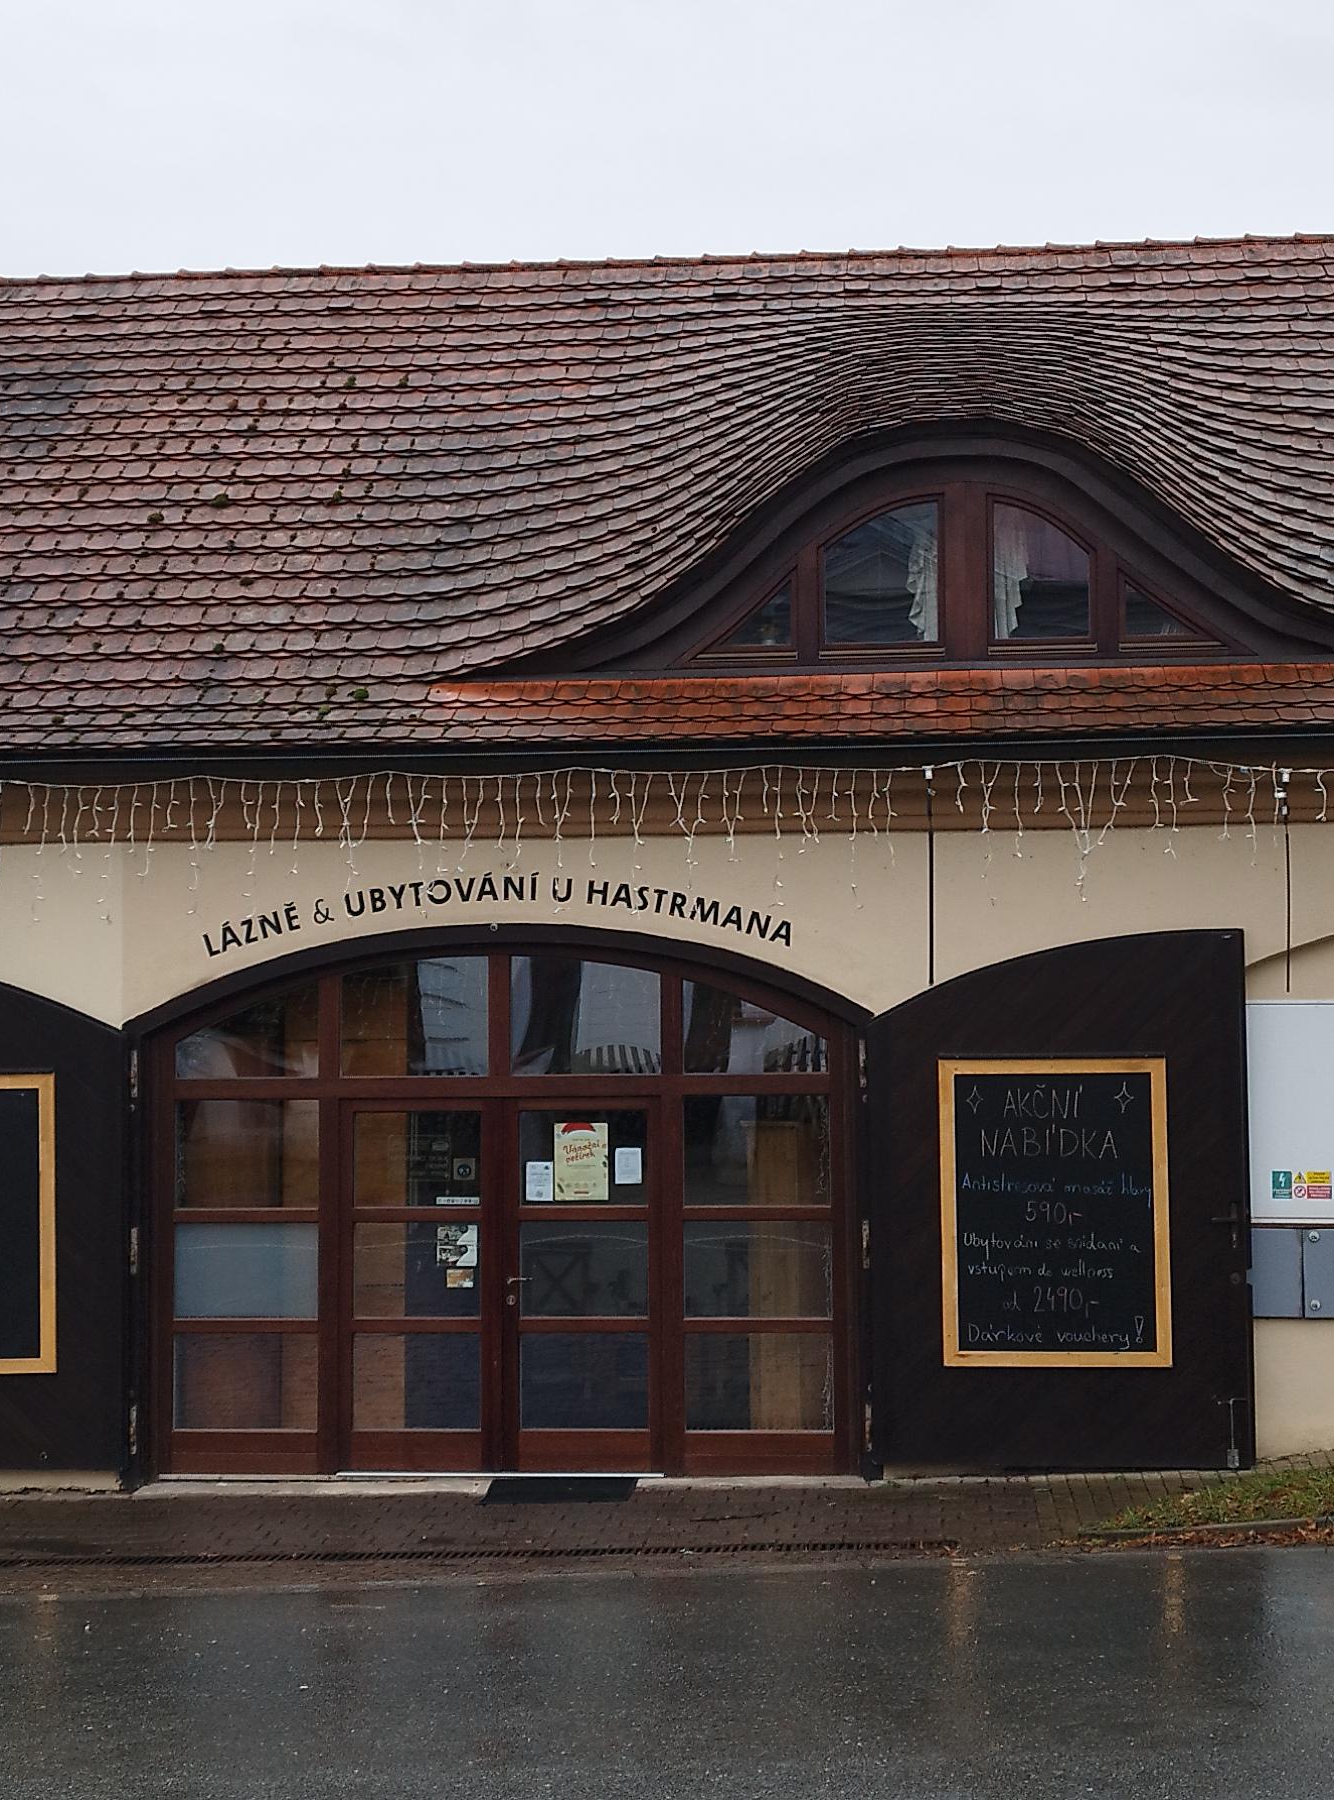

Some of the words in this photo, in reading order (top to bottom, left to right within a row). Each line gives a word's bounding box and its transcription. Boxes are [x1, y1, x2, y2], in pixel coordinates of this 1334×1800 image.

[202, 901, 301, 957] LÁZNĚ
[313, 898, 335, 925] &
[344, 871, 539, 917] UBYTOVÁNÍ
[552, 877, 573, 903] U
[586, 879, 792, 947] HASTRMANA
[1003, 1084, 1083, 1119] AKČNÍ
[981, 1123, 1119, 1160] NABÍDKA
